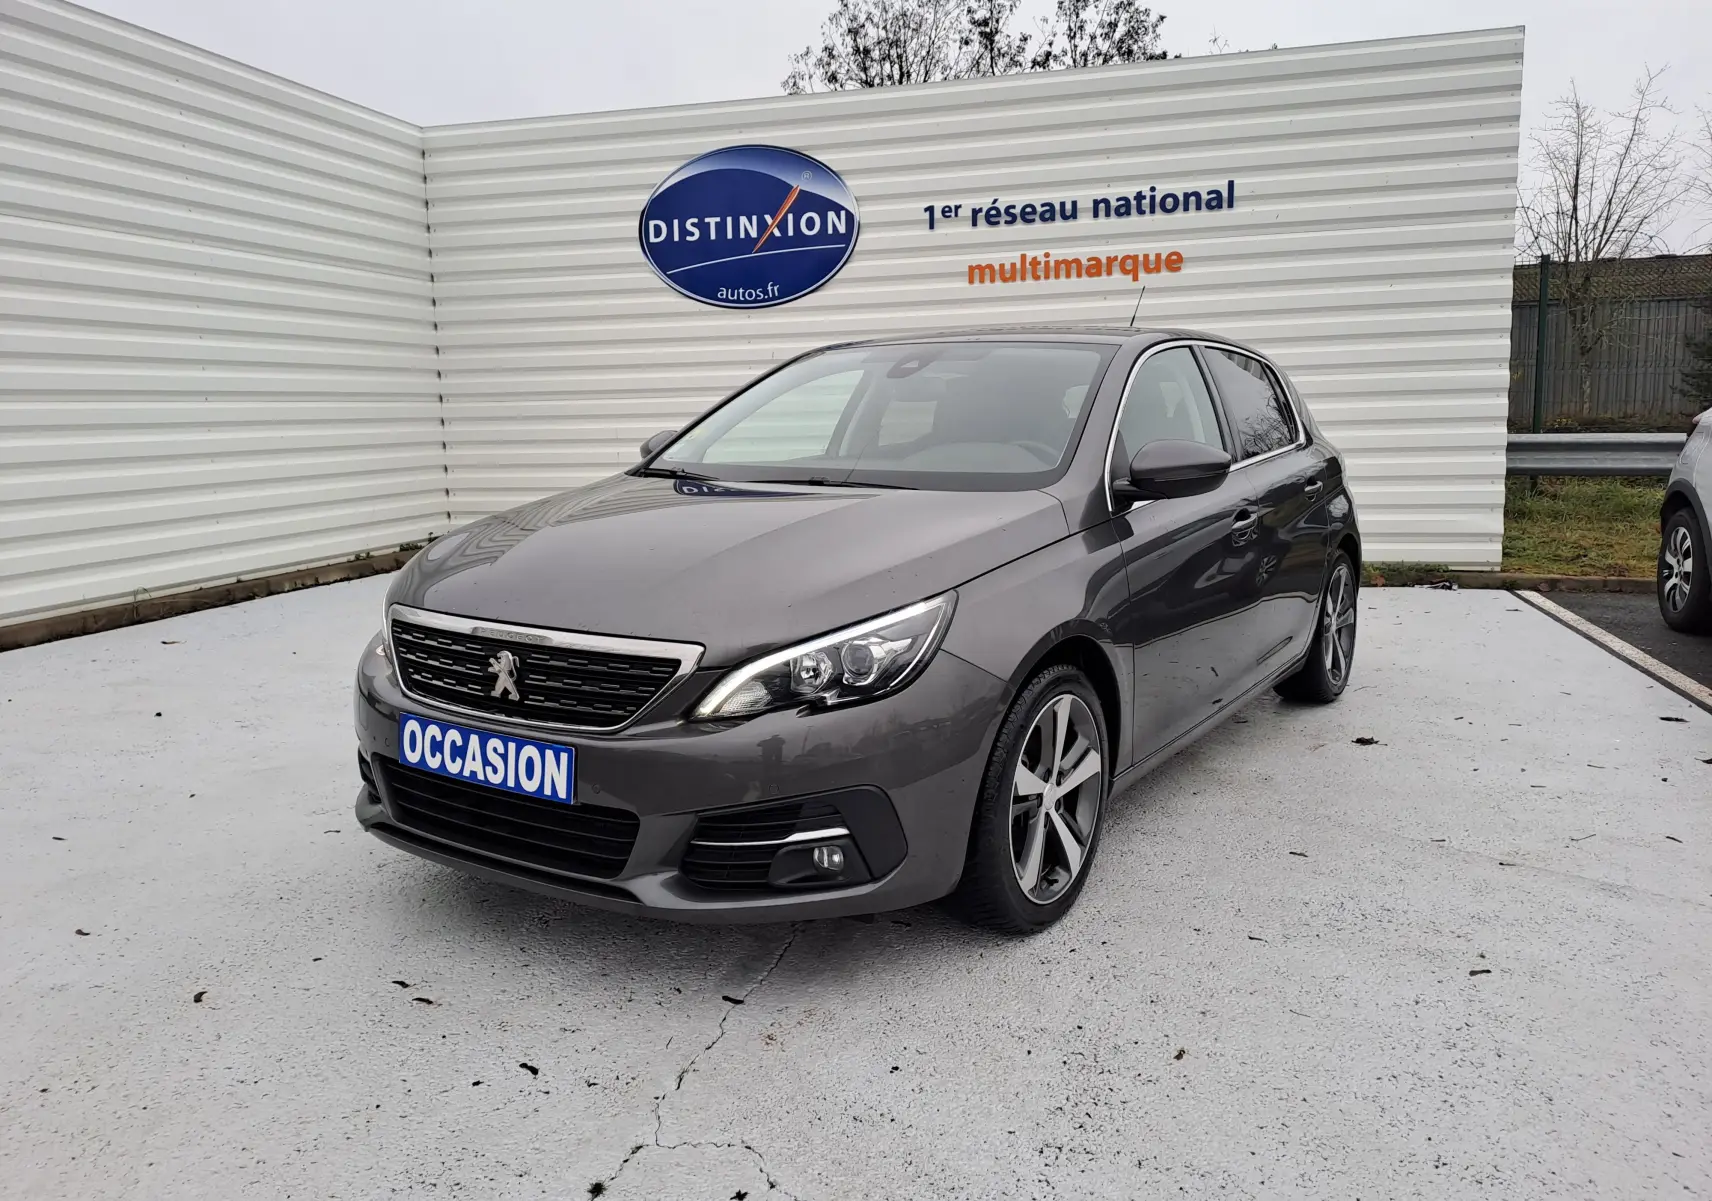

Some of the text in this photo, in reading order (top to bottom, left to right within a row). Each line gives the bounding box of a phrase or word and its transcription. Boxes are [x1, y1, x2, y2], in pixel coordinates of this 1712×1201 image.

[923, 180, 1235, 230] 1er réseau national
[648, 209, 846, 243] DISTINXION
[968, 250, 1184, 284] multimarque
[717, 281, 780, 300] autos.fr
[480, 627, 543, 643] PEUGEOT
[403, 719, 568, 799] OCCASION
